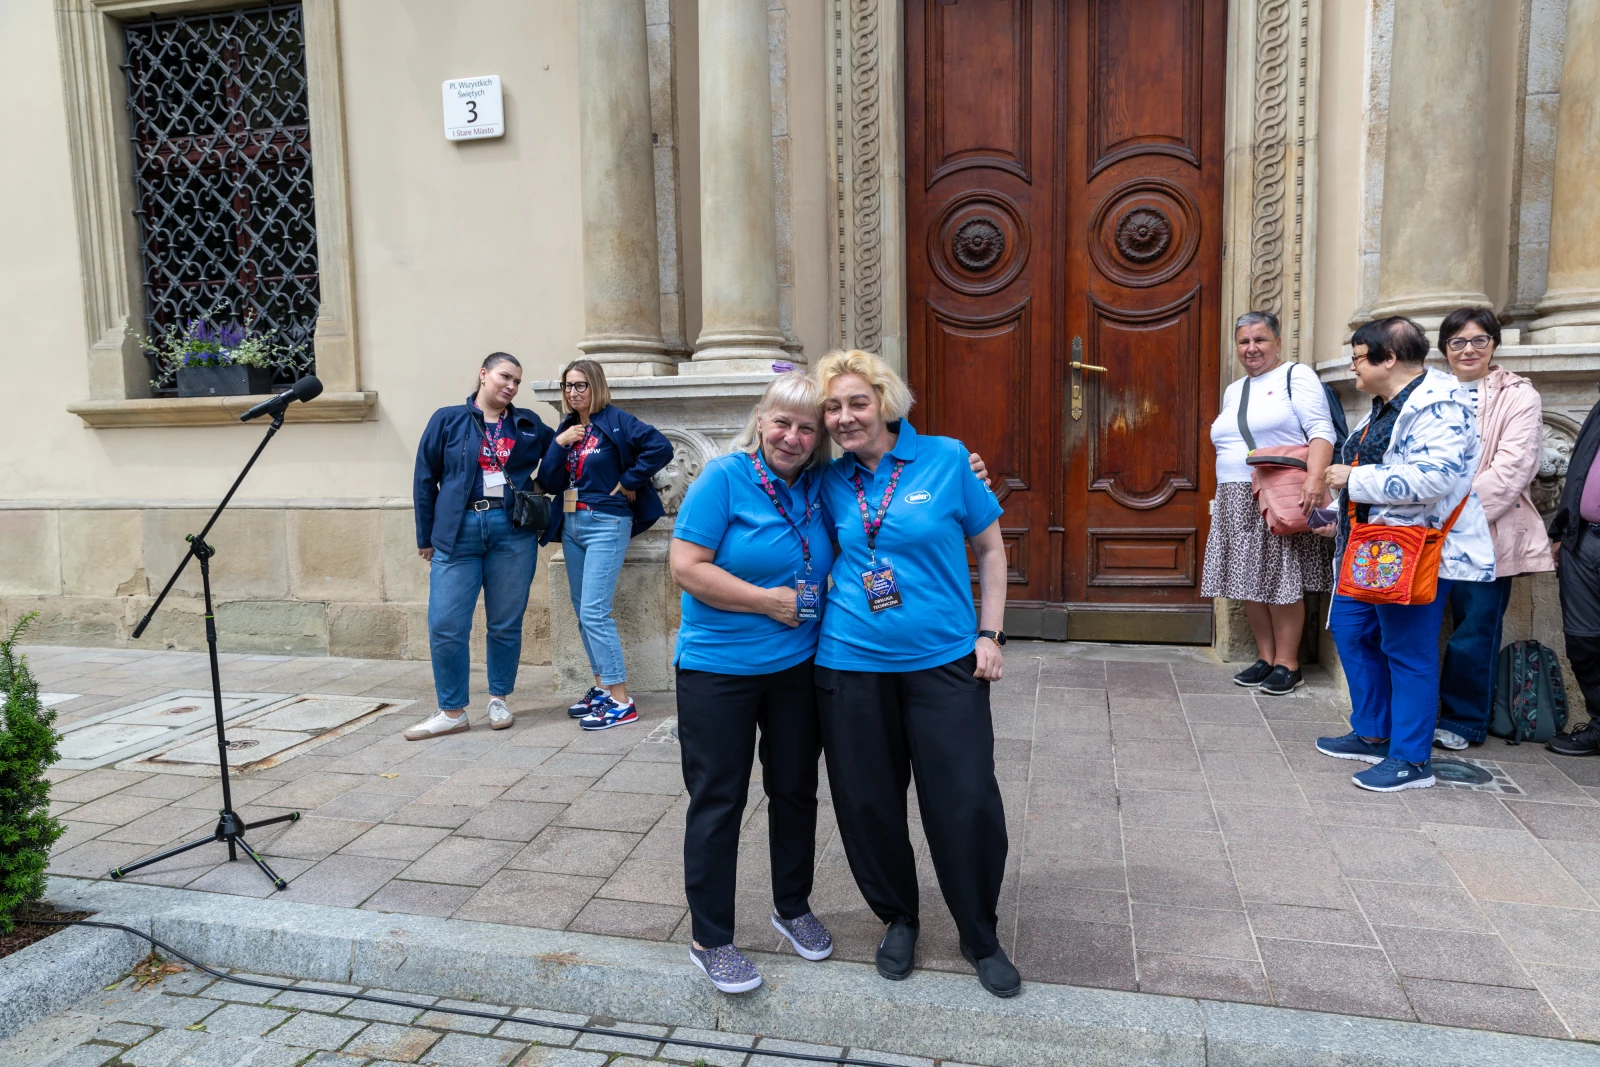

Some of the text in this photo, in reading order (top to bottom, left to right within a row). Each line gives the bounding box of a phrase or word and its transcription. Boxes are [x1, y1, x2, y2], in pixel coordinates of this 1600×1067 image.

[458, 79, 493, 89] Wszystkich
[457, 89, 485, 99] Świętych
[466, 100, 478, 123] 3
[456, 129, 472, 137] Stare
[473, 127, 494, 135] Miasto
